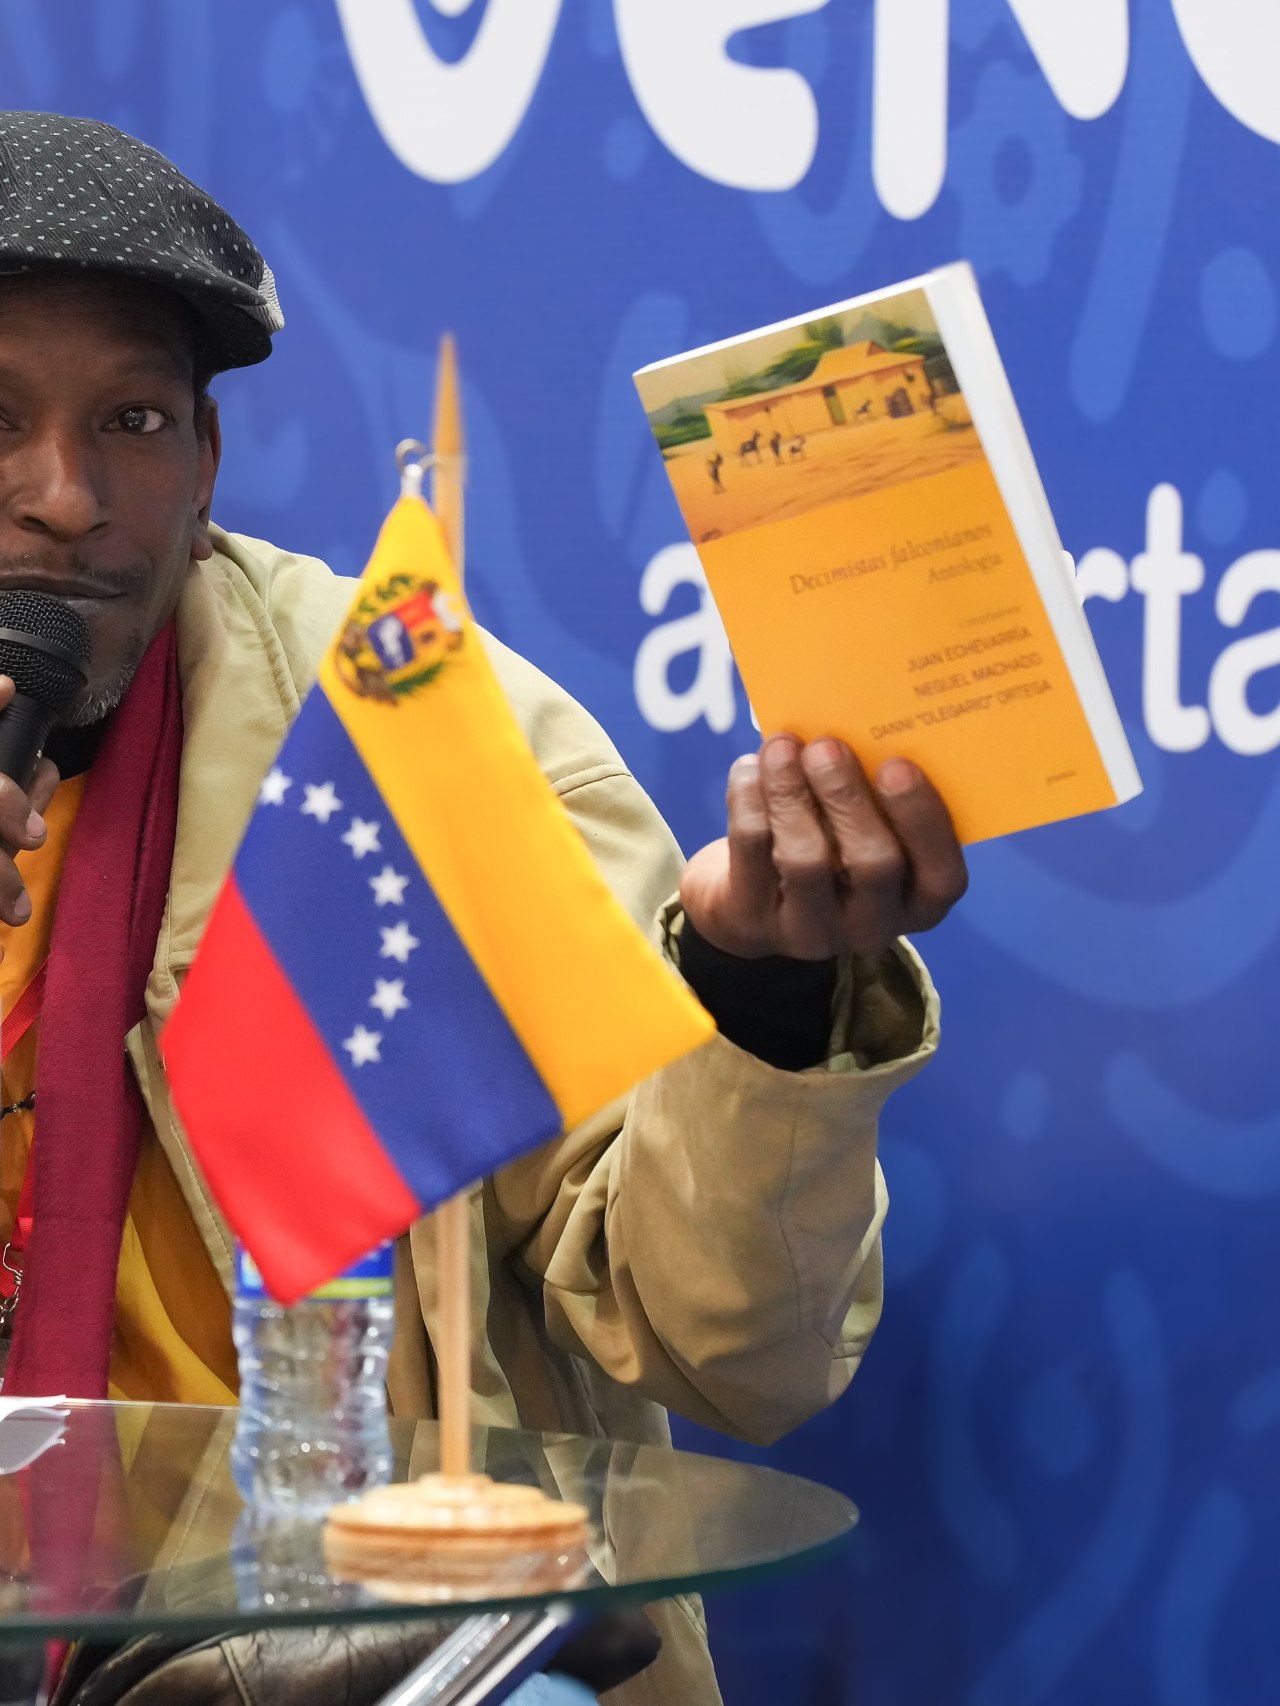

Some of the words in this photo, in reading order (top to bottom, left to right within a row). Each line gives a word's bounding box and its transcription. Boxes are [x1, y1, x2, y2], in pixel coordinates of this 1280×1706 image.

[788, 554, 888, 595] Decimistas
[889, 523, 993, 573] falconianos
[633, 482, 1280, 757] arta
[906, 653, 944, 673] JUAN
[971, 652, 1043, 682] MACHADO
